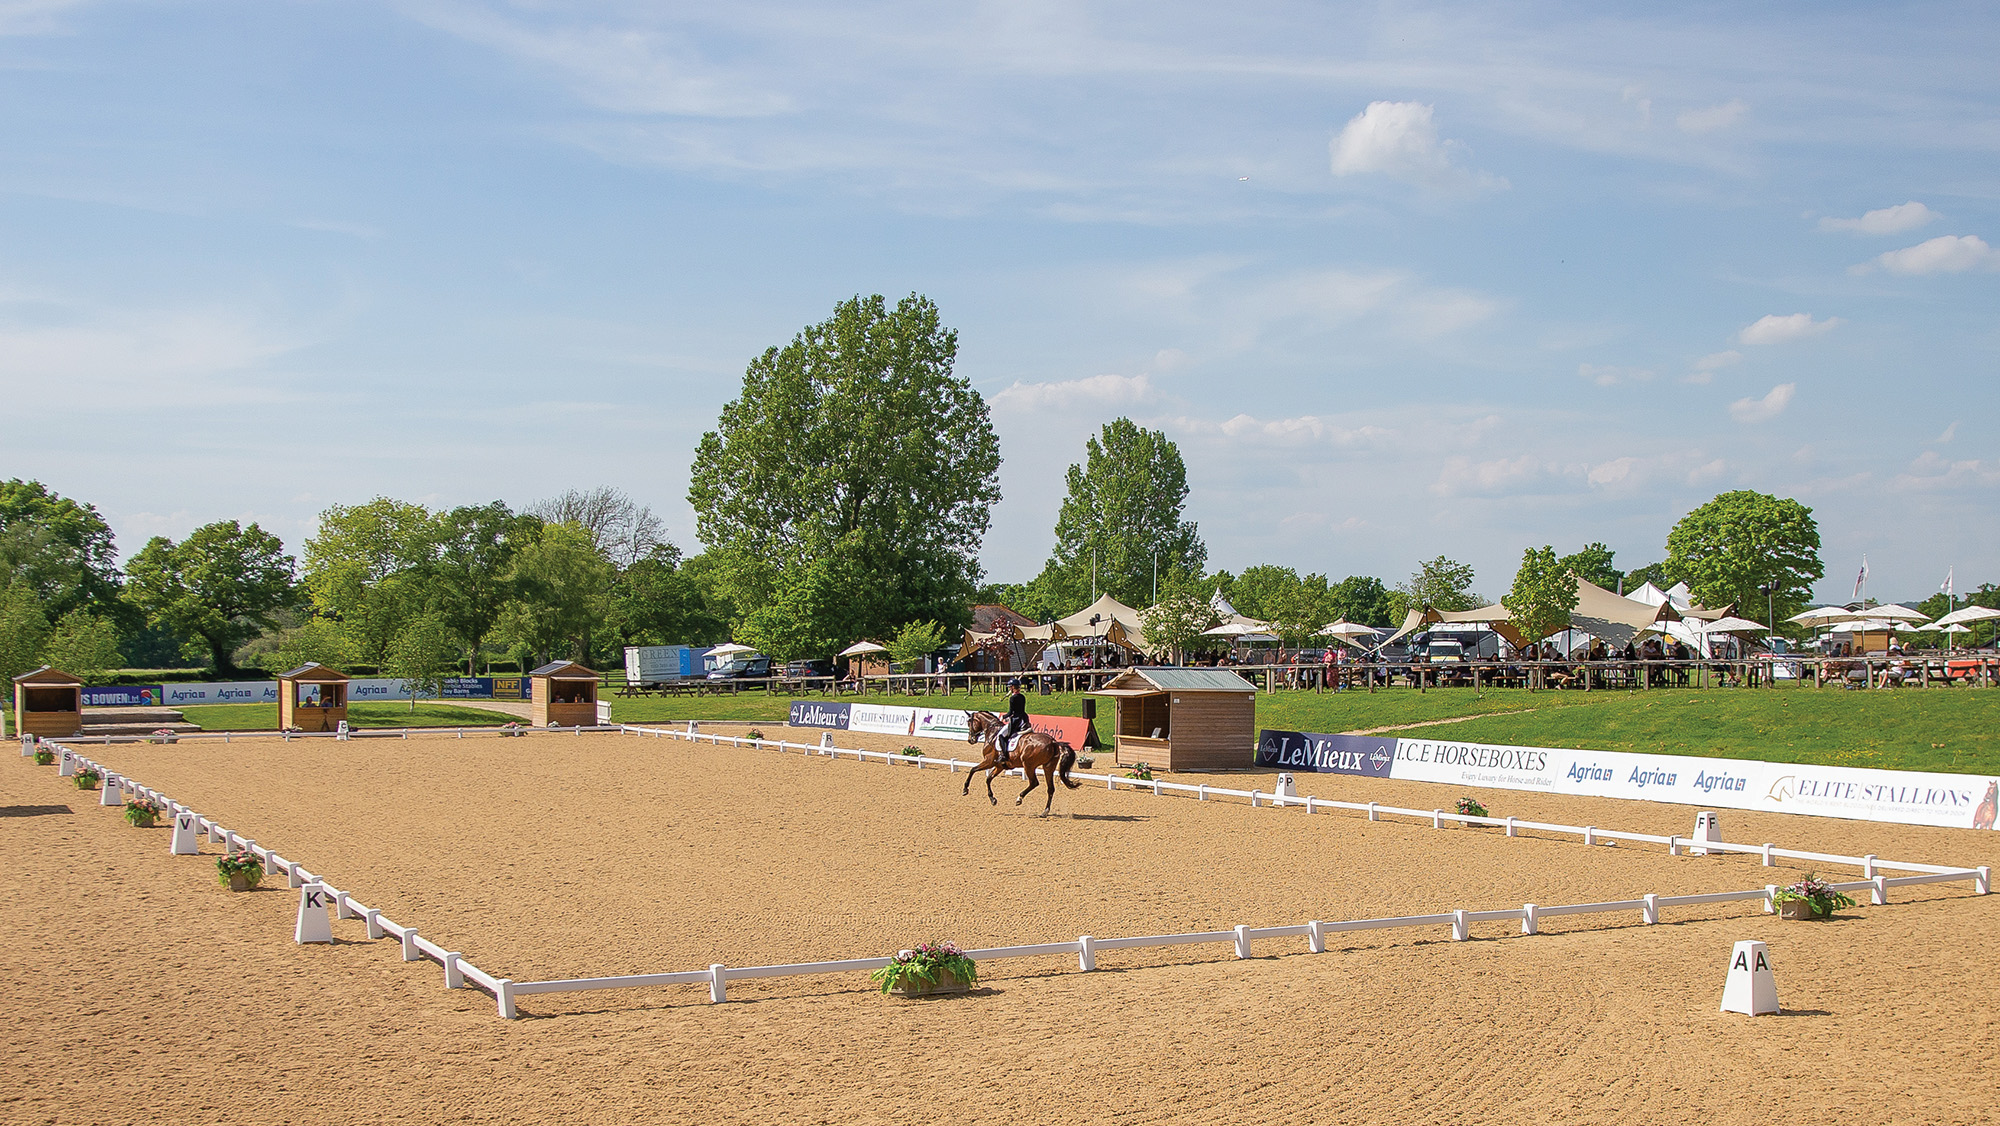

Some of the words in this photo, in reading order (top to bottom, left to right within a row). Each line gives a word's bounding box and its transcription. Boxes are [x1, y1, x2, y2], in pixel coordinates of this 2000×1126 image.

[355, 685, 380, 696] Agria
[496, 680, 518, 689] NFF
[92, 693, 127, 705] BOWEN
[171, 690, 198, 701] Agria
[217, 688, 244, 699] Agria
[798, 704, 837, 726] LeMieux
[936, 714, 959, 726] ELITE
[64, 753, 71, 761] S
[1277, 738, 1365, 771] LeMieux
[1396, 742, 1431, 762] I.C.E
[1434, 745, 1548, 772] HORSEBOXES
[1567, 762, 1602, 783] Agria
[1628, 766, 1665, 788] Agria
[107, 777, 116, 787] E
[1286, 777, 1293, 786] P
[1536, 777, 1552, 786] Rider
[1694, 770, 1733, 792] Agria
[1798, 780, 1858, 799] ELITE
[1862, 784, 1972, 808] STALLIONS
[180, 818, 191, 830] V
[1697, 817, 1705, 828] F
[1708, 817, 1716, 829] F
[306, 891, 323, 909] K
[1733, 951, 1748, 971] A
[1755, 951, 1769, 972] A
